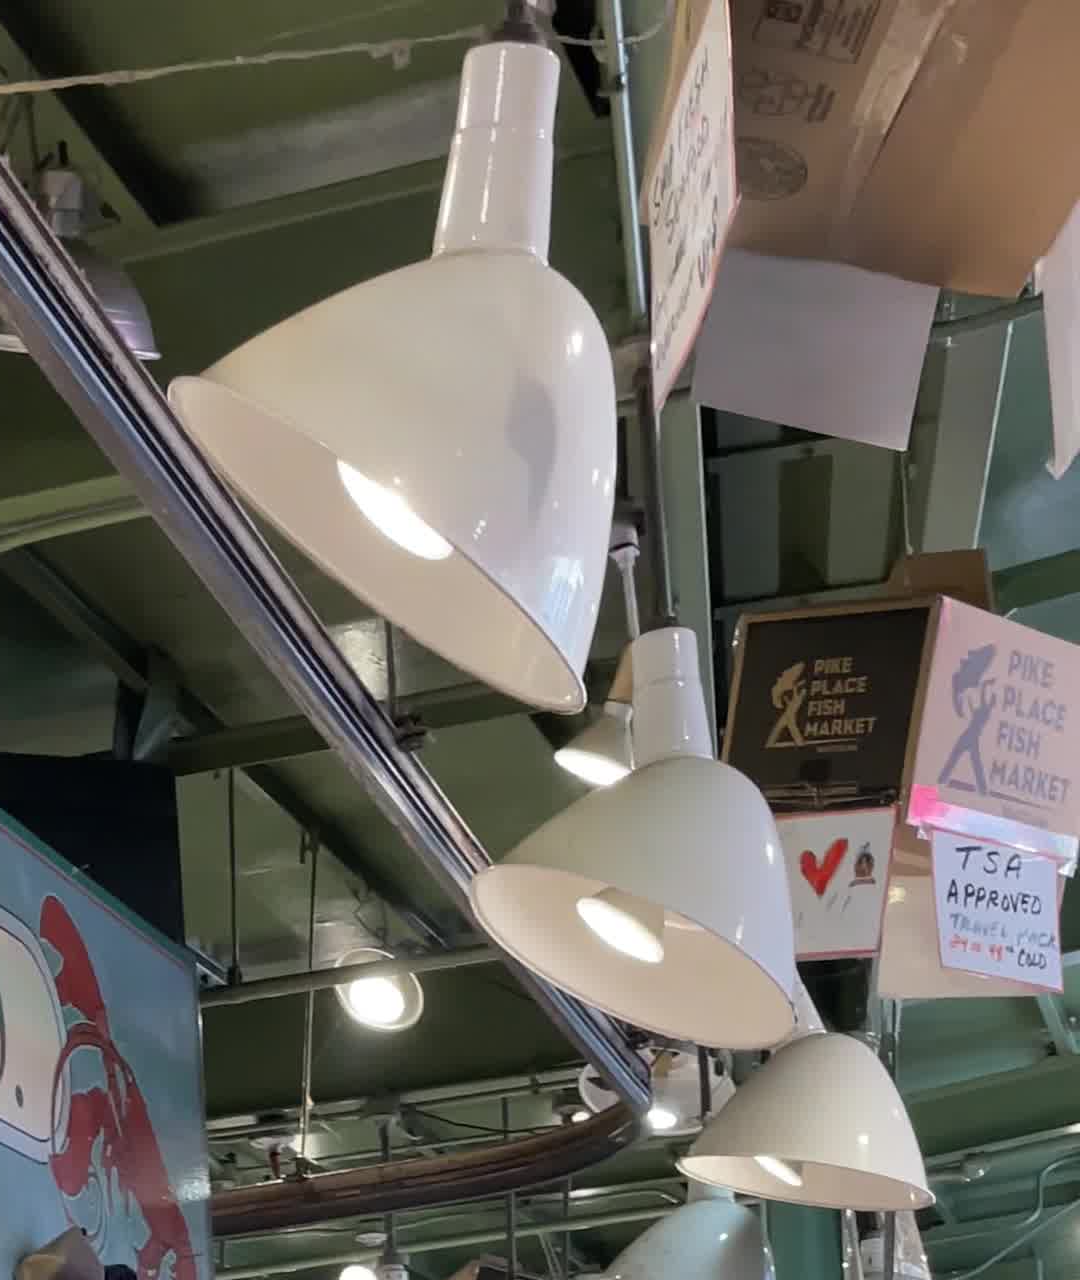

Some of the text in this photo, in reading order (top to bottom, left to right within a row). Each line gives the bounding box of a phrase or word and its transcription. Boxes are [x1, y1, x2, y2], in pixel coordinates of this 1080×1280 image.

[813, 656, 854, 674] PIKE
[1007, 649, 1055, 688] PIKE
[809, 675, 870, 697] PLACE
[808, 698, 846, 717] FISH
[1001, 685, 1067, 731] PLACE
[803, 716, 878, 737] MARKET
[996, 719, 1041, 761] FISH
[987, 758, 1071, 804] MARKET
[955, 845, 1022, 879] TSA
[946, 878, 1042, 915] APPROVED
